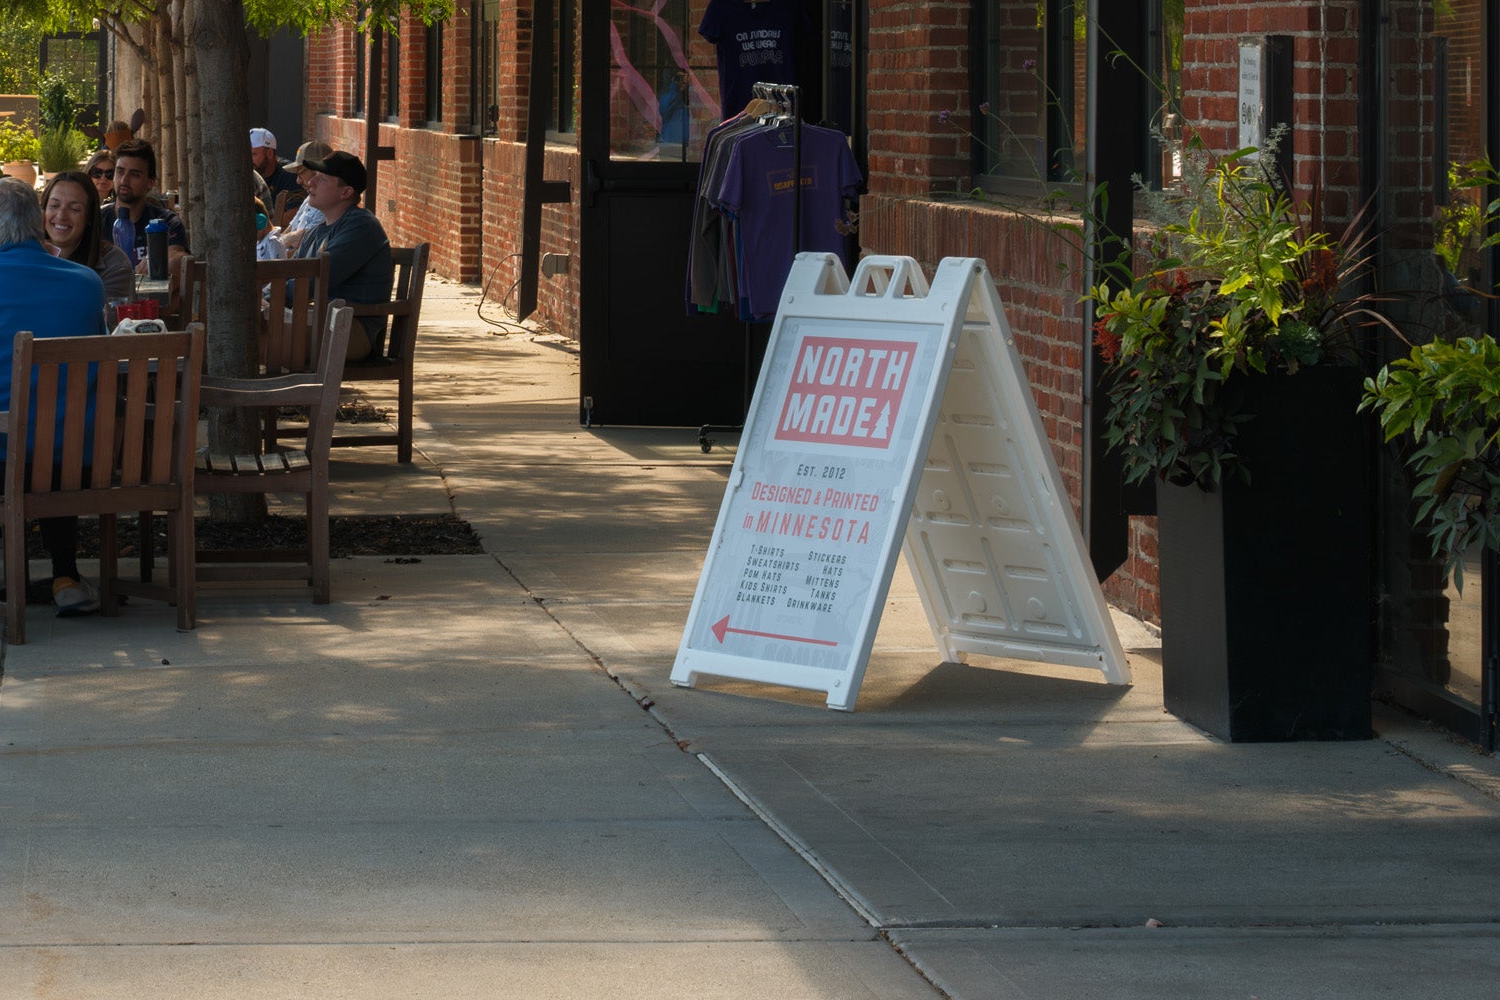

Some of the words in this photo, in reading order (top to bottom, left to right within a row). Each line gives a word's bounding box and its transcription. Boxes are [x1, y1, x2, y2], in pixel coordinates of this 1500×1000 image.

[742, 41, 755, 51] WE
[797, 345, 909, 391] NORTH
[782, 392, 877, 437] MADE
[797, 464, 817, 478] EST.
[822, 466, 846, 480] 2012
[751, 481, 812, 505] DESIGNED
[813, 491, 821, 506] &
[823, 488, 879, 512] PRINTED
[743, 512, 753, 529] in
[755, 510, 870, 544] MINNESOTA
[751, 545, 785, 557] T-SHIRTS
[808, 551, 847, 565] STICKERS
[747, 556, 800, 571] SWEATSHIRTS
[822, 565, 843, 577] HATS
[743, 568, 759, 579] POM
[761, 570, 781, 582] HATS
[806, 575, 840, 589] MITTENS
[740, 580, 758, 591] KIDS
[760, 582, 787, 595] SHIRTS
[811, 588, 836, 601] TANKS
[736, 591, 776, 606] BLANKETS
[787, 597, 833, 613] DRINKWARE
